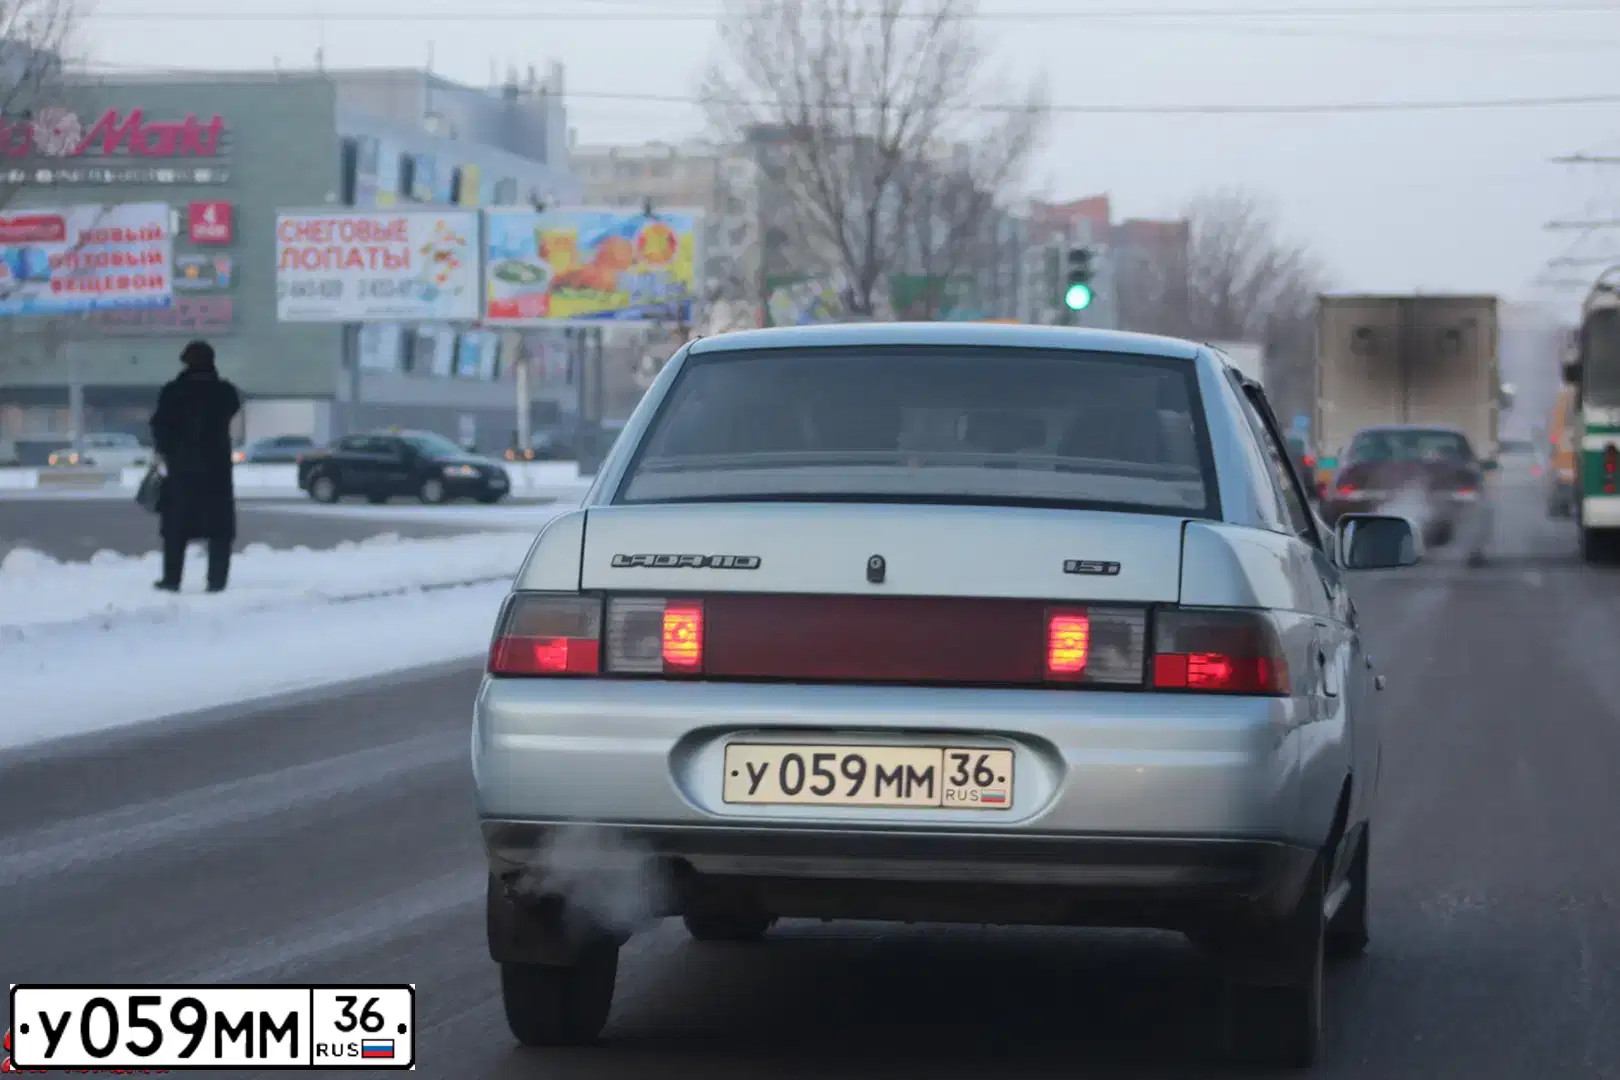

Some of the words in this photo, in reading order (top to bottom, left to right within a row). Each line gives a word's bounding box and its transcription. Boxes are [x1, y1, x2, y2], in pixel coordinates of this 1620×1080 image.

[279, 219, 408, 243] СНЕГОВЫЕ
[279, 246, 410, 271] ЛОПАТЫ
[950, 753, 994, 787] 36
[946, 789, 979, 801] RUS
